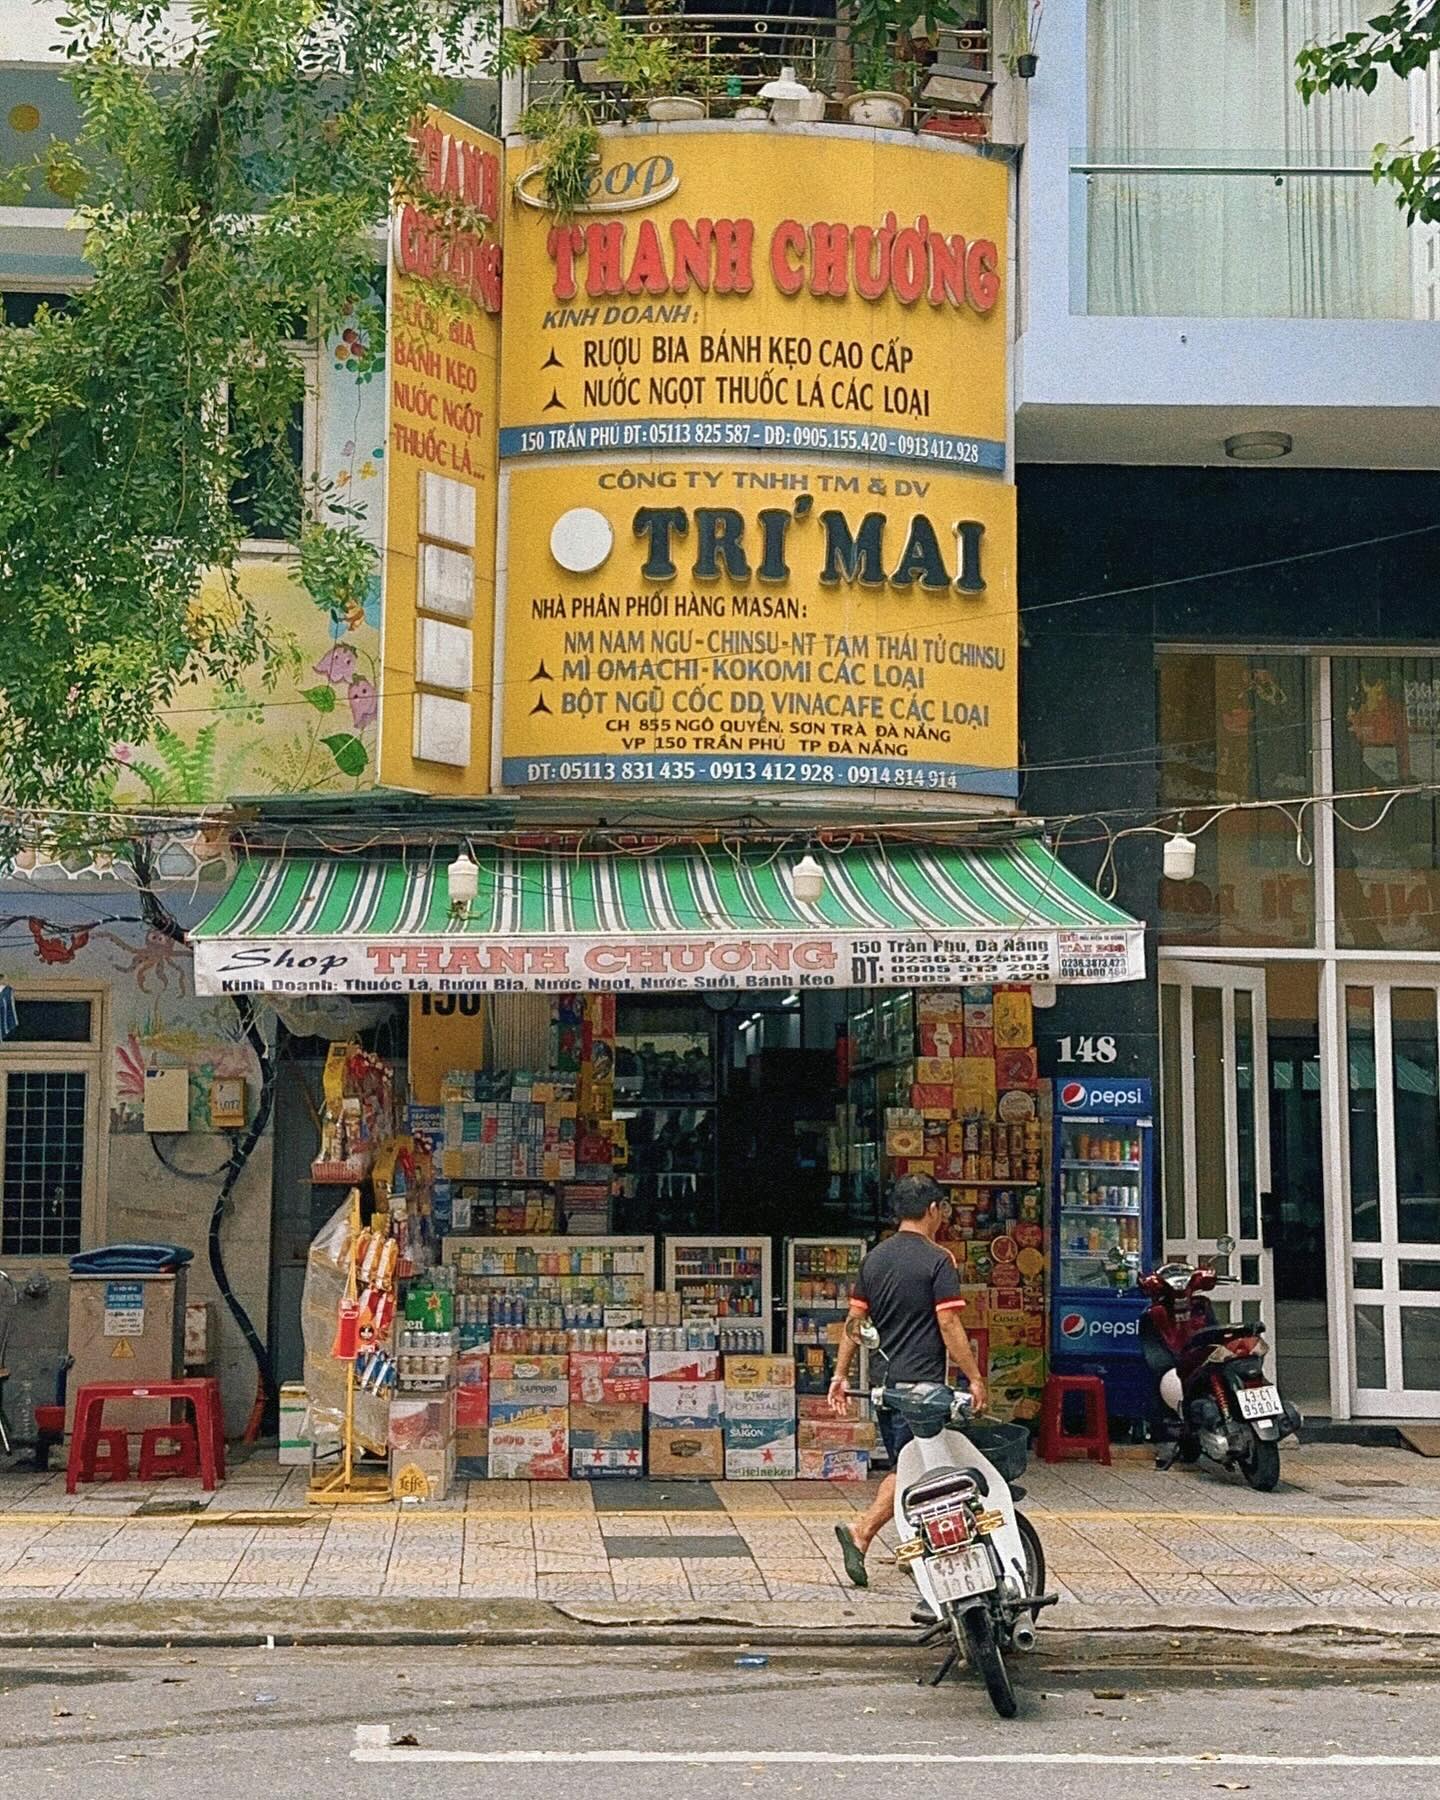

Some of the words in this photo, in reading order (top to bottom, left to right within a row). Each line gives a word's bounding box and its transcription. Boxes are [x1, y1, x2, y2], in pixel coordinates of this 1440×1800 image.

[547, 218, 754, 299] THANH
[771, 211, 1000, 312] CHƯƠNG
[542, 307, 599, 329] KINH
[584, 336, 641, 371] RƯỢU
[653, 336, 689, 363] BIA
[701, 327, 761, 364] BÁNH
[769, 337, 811, 370] KẸO
[818, 339, 863, 369] CAO
[871, 337, 912, 373] CẤP
[446, 357, 476, 395] KẸO
[584, 372, 640, 407] NƯỚC
[649, 377, 705, 409] NGỌT
[716, 368, 788, 404] THUỐC
[797, 374, 824, 408] LÁ
[831, 374, 873, 411] CÁC
[884, 386, 929, 420] LOẠI
[394, 423, 446, 466] THUỐC
[521, 431, 544, 451] 150
[590, 423, 620, 446] PHÚ
[650, 424, 690, 443] 05113
[695, 424, 721, 442] 825
[725, 425, 750, 443] 587
[599, 469, 676, 489] CÔNG
[687, 471, 723, 488] TY
[733, 471, 808, 490] TNHH
[817, 476, 859, 493] TM
[895, 480, 930, 497] DV
[818, 510, 987, 595] MAI
[532, 594, 566, 619] NHÀ
[572, 593, 620, 618] PHÂN
[626, 589, 668, 617] PHỐI
[675, 593, 725, 616] HÀNG
[564, 631, 594, 654] NM
[599, 630, 644, 653] NAM
[824, 634, 868, 658] TAM
[876, 633, 917, 661] THÁI
[923, 633, 946, 663] TỬ
[950, 642, 1005, 671] CHINSU
[562, 659, 590, 681] MÌ
[818, 658, 866, 685] CÁC
[874, 664, 924, 692] LOẠI
[562, 688, 608, 718] BỘT
[616, 686, 664, 713] NGŨ
[672, 683, 723, 712] CỐC
[771, 691, 885, 718] VINACAFE
[890, 690, 934, 722] CÁC
[943, 701, 989, 729] LOẠI
[606, 720, 629, 731] CH
[639, 720, 671, 731] 855
[676, 717, 713, 731] NGÔ
[790, 721, 825, 735] SƠN
[831, 722, 866, 736] TRÀ
[876, 723, 898, 737] ĐÀ
[622, 738, 645, 748] VP
[656, 737, 687, 748] 150
[749, 736, 785, 750] PHÚ
[800, 740, 821, 752] TP
[828, 740, 853, 753] ĐÀ
[560, 763, 615, 779] 05113
[622, 762, 654, 779] 831
[660, 762, 695, 779] 435
[710, 762, 756, 779] 0913
[761, 763, 800, 780] 412
[801, 764, 834, 782] 928
[847, 766, 890, 784] 0914
[895, 768, 924, 786] 814
[216, 949, 348, 975] Shop
[367, 947, 569, 974] THANH
[584, 940, 837, 973] CHƯƠNG
[851, 941, 881, 954] 150
[887, 938, 926, 953] Trần
[891, 965, 951, 973] 0905
[1005, 963, 1050, 972] 203
[891, 975, 951, 983] 0905
[1006, 973, 1050, 982] 420
[222, 980, 266, 991] Kinh
[272, 980, 338, 991] Doanh:
[746, 974, 792, 987] Bánh
[1057, 1036, 1117, 1063] 148
[1090, 1088, 1141, 1107] pepsi
[1090, 1319, 1139, 1337] pepsi
[399, 1474, 425, 1491] Leffe
[742, 1467, 794, 1477] Heineken
